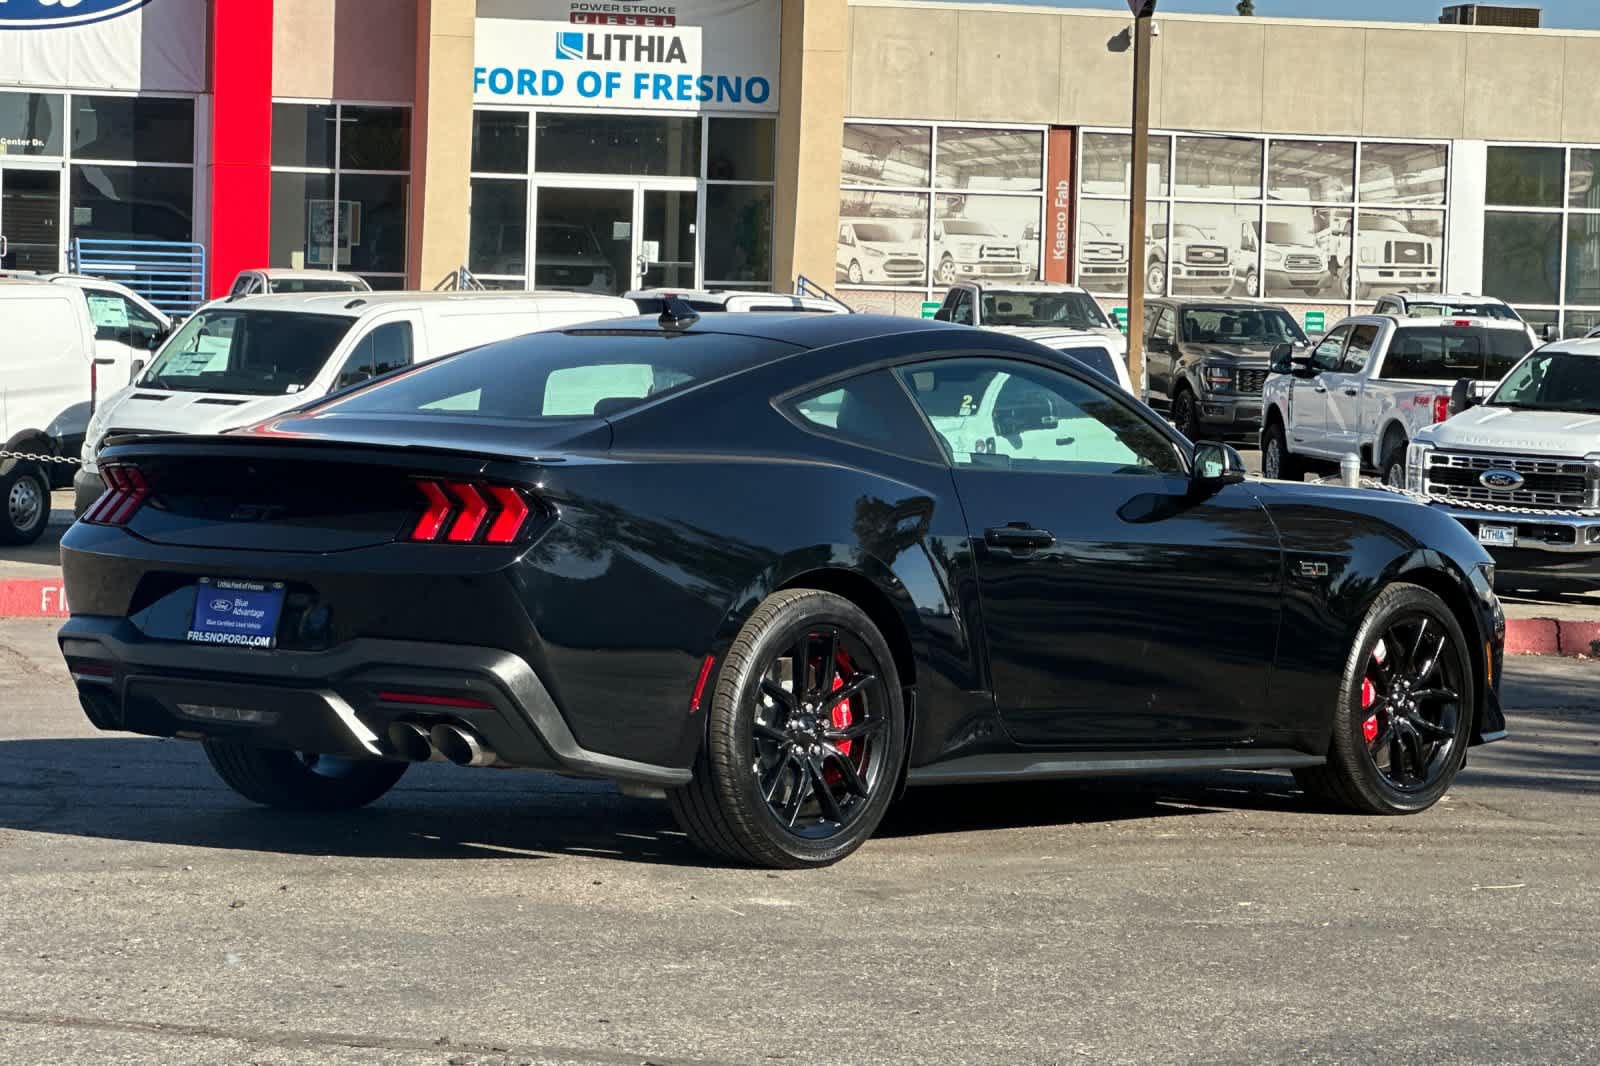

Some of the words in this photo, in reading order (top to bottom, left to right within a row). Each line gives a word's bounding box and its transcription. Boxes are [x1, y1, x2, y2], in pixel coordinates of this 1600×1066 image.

[570, 3, 619, 11] POWER
[622, 5, 676, 14] STROKE
[574, 14, 673, 26] DIESEL
[587, 33, 687, 63] LITHIA
[474, 67, 564, 97] FORD
[576, 71, 621, 98] OF
[633, 73, 770, 104] FRESNO
[0, 137, 31, 146] Center
[32, 138, 45, 147] Dr.
[1055, 180, 1069, 208] Fab
[1052, 212, 1066, 259] Kasco
[41, 586, 70, 612] FI
[234, 599, 248, 607] Blue
[233, 608, 264, 618] Advantage
[187, 631, 270, 647] FRESNOFORD.COM
